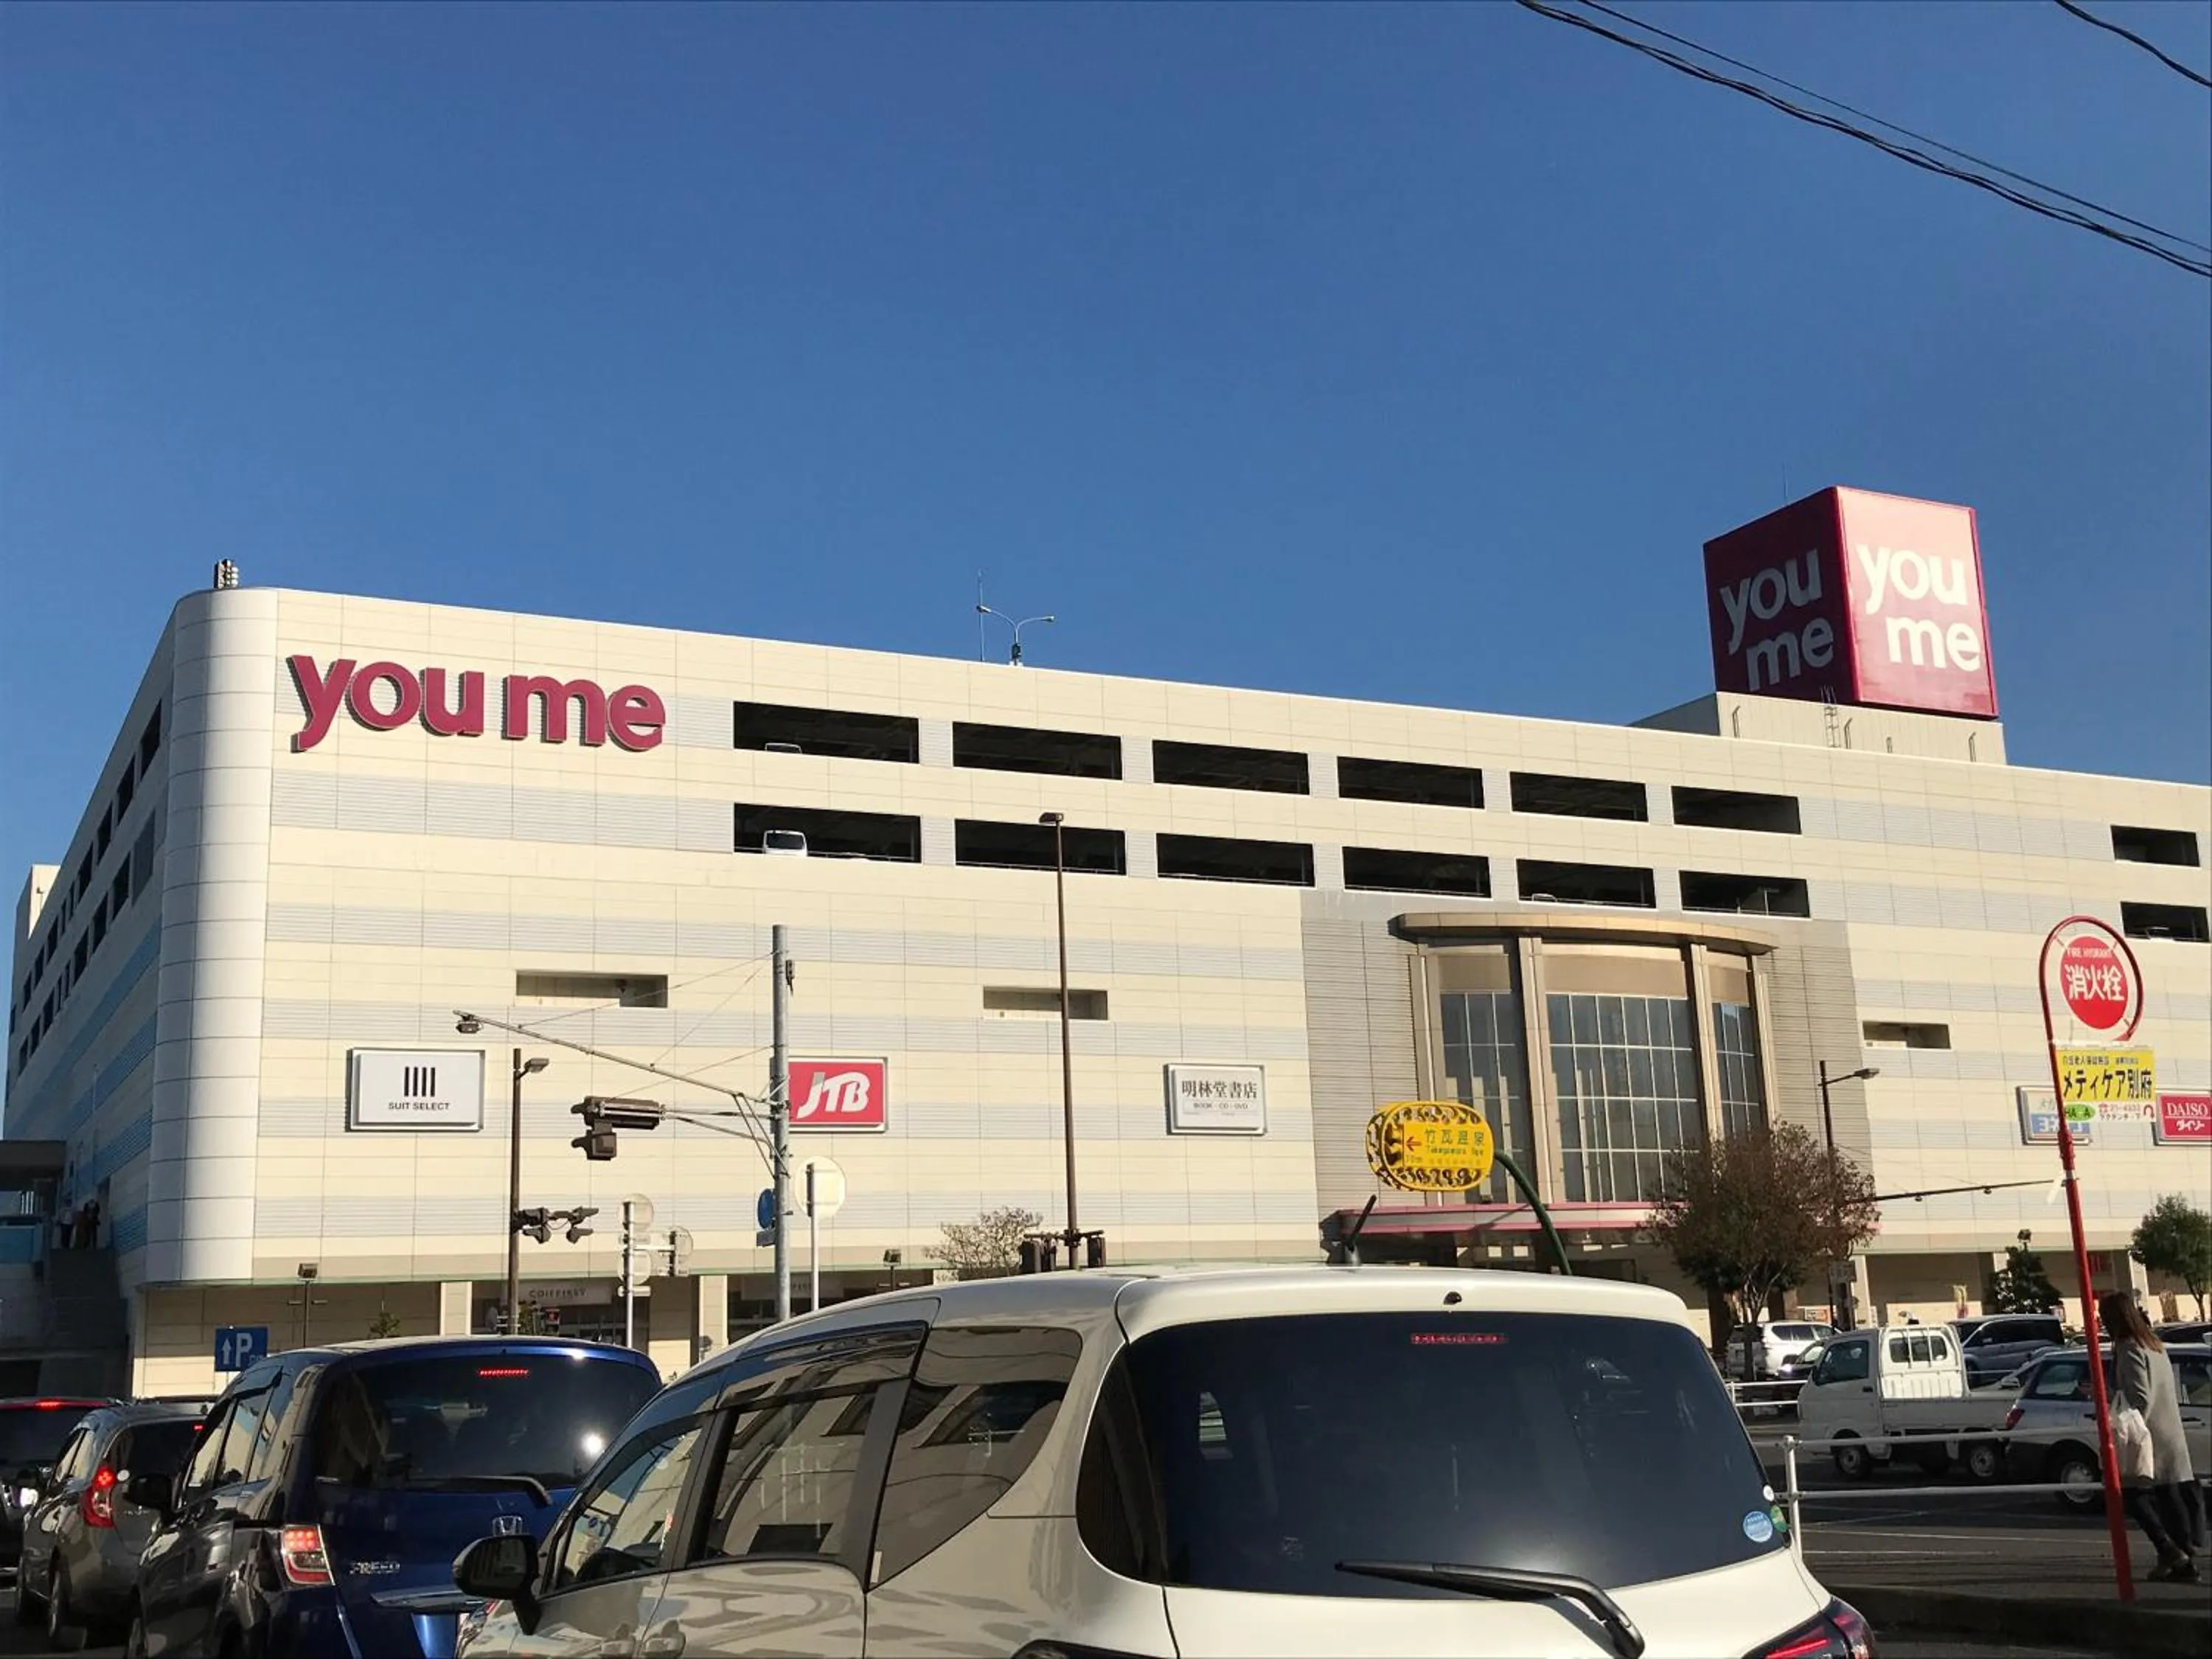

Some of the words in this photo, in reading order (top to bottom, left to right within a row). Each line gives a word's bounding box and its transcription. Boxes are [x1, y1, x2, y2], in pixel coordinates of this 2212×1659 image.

[1719, 549, 1822, 655] you
[1856, 543, 1968, 615] you
[1746, 616, 1834, 692] me
[1885, 614, 1981, 672] me
[286, 654, 484, 753] you
[501, 675, 666, 752] me
[2064, 964, 2125, 1000] 消火栓
[412, 1102, 449, 1110] SELECT
[796, 1071, 870, 1119] JTB
[1182, 1080, 1257, 1099] 明林堂書店
[2166, 1102, 2208, 1116] DAISO
[235, 1332, 253, 1367] P
